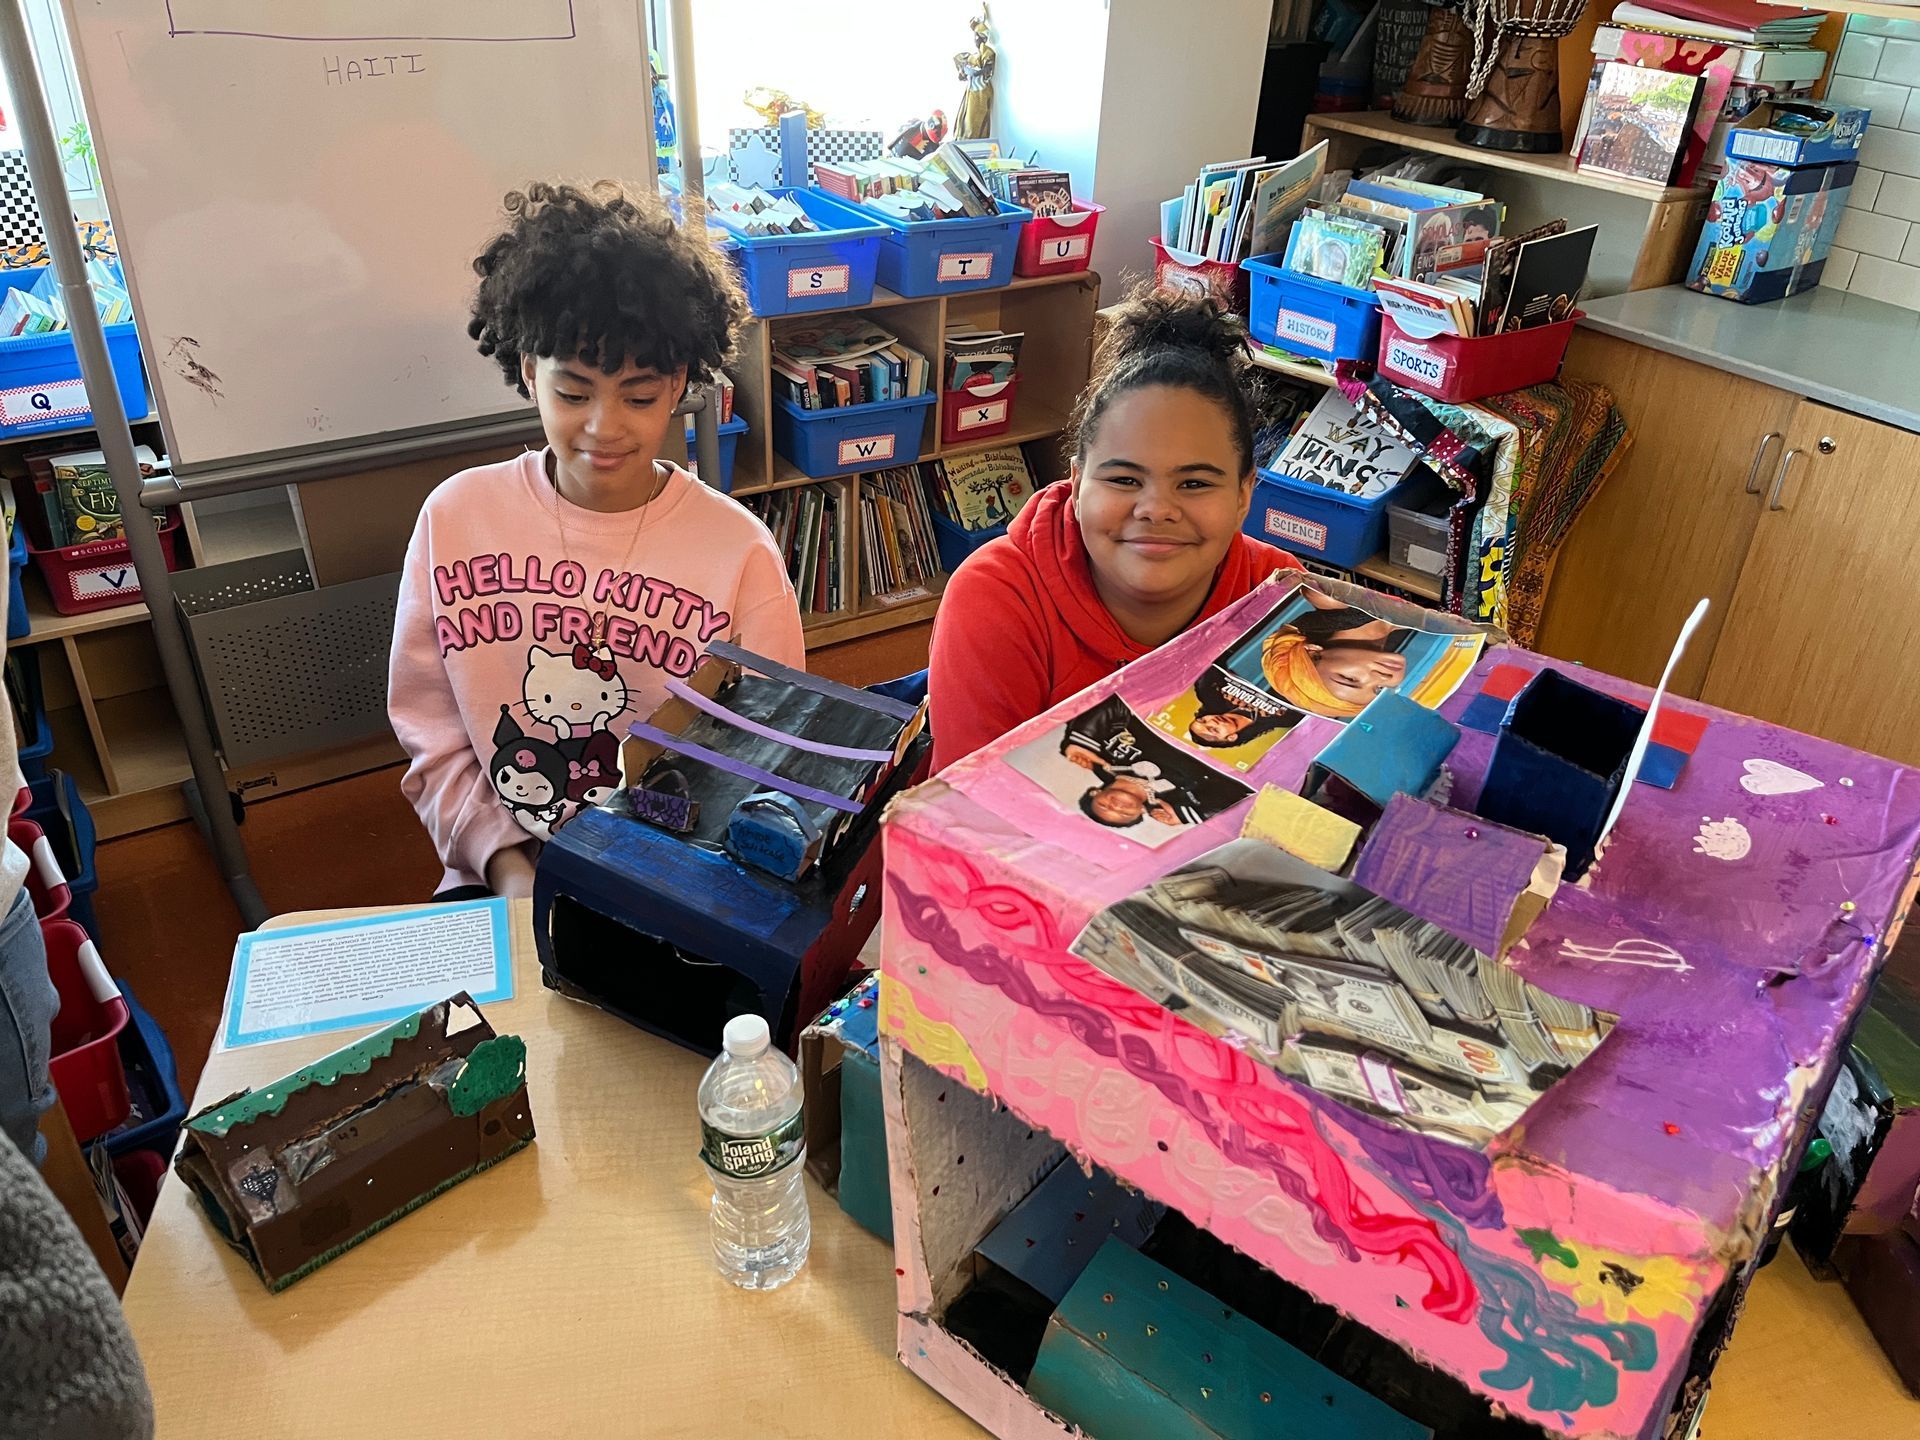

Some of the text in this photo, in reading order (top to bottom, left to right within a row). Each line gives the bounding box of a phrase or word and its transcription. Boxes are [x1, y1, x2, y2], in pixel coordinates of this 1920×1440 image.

[323, 54, 426, 85] HAITI
[1057, 240, 1070, 257] U
[958, 259, 973, 275] T
[1714, 249, 1732, 280] VALUE
[1724, 253, 1738, 278] PACK
[810, 272, 823, 289] S
[1287, 317, 1330, 342] HISTORY
[990, 344, 1015, 355] GIRL
[1393, 348, 1439, 379] SPORTS
[31, 392, 52, 410] Q
[977, 408, 989, 422] X
[855, 441, 877, 457] W
[1324, 421, 1395, 464] WAY
[948, 459, 975, 479] Waiting
[1293, 433, 1402, 493] THINGS
[1272, 516, 1321, 541] SCIENCE
[99, 569, 127, 589] V
[434, 553, 730, 643] HELLO KITTY
[435, 602, 523, 658] AND
[1220, 682, 1256, 707] BANDZ
[1253, 697, 1279, 715] STAR
[720, 1136, 773, 1157] Poland
[722, 1149, 776, 1171] Spring
